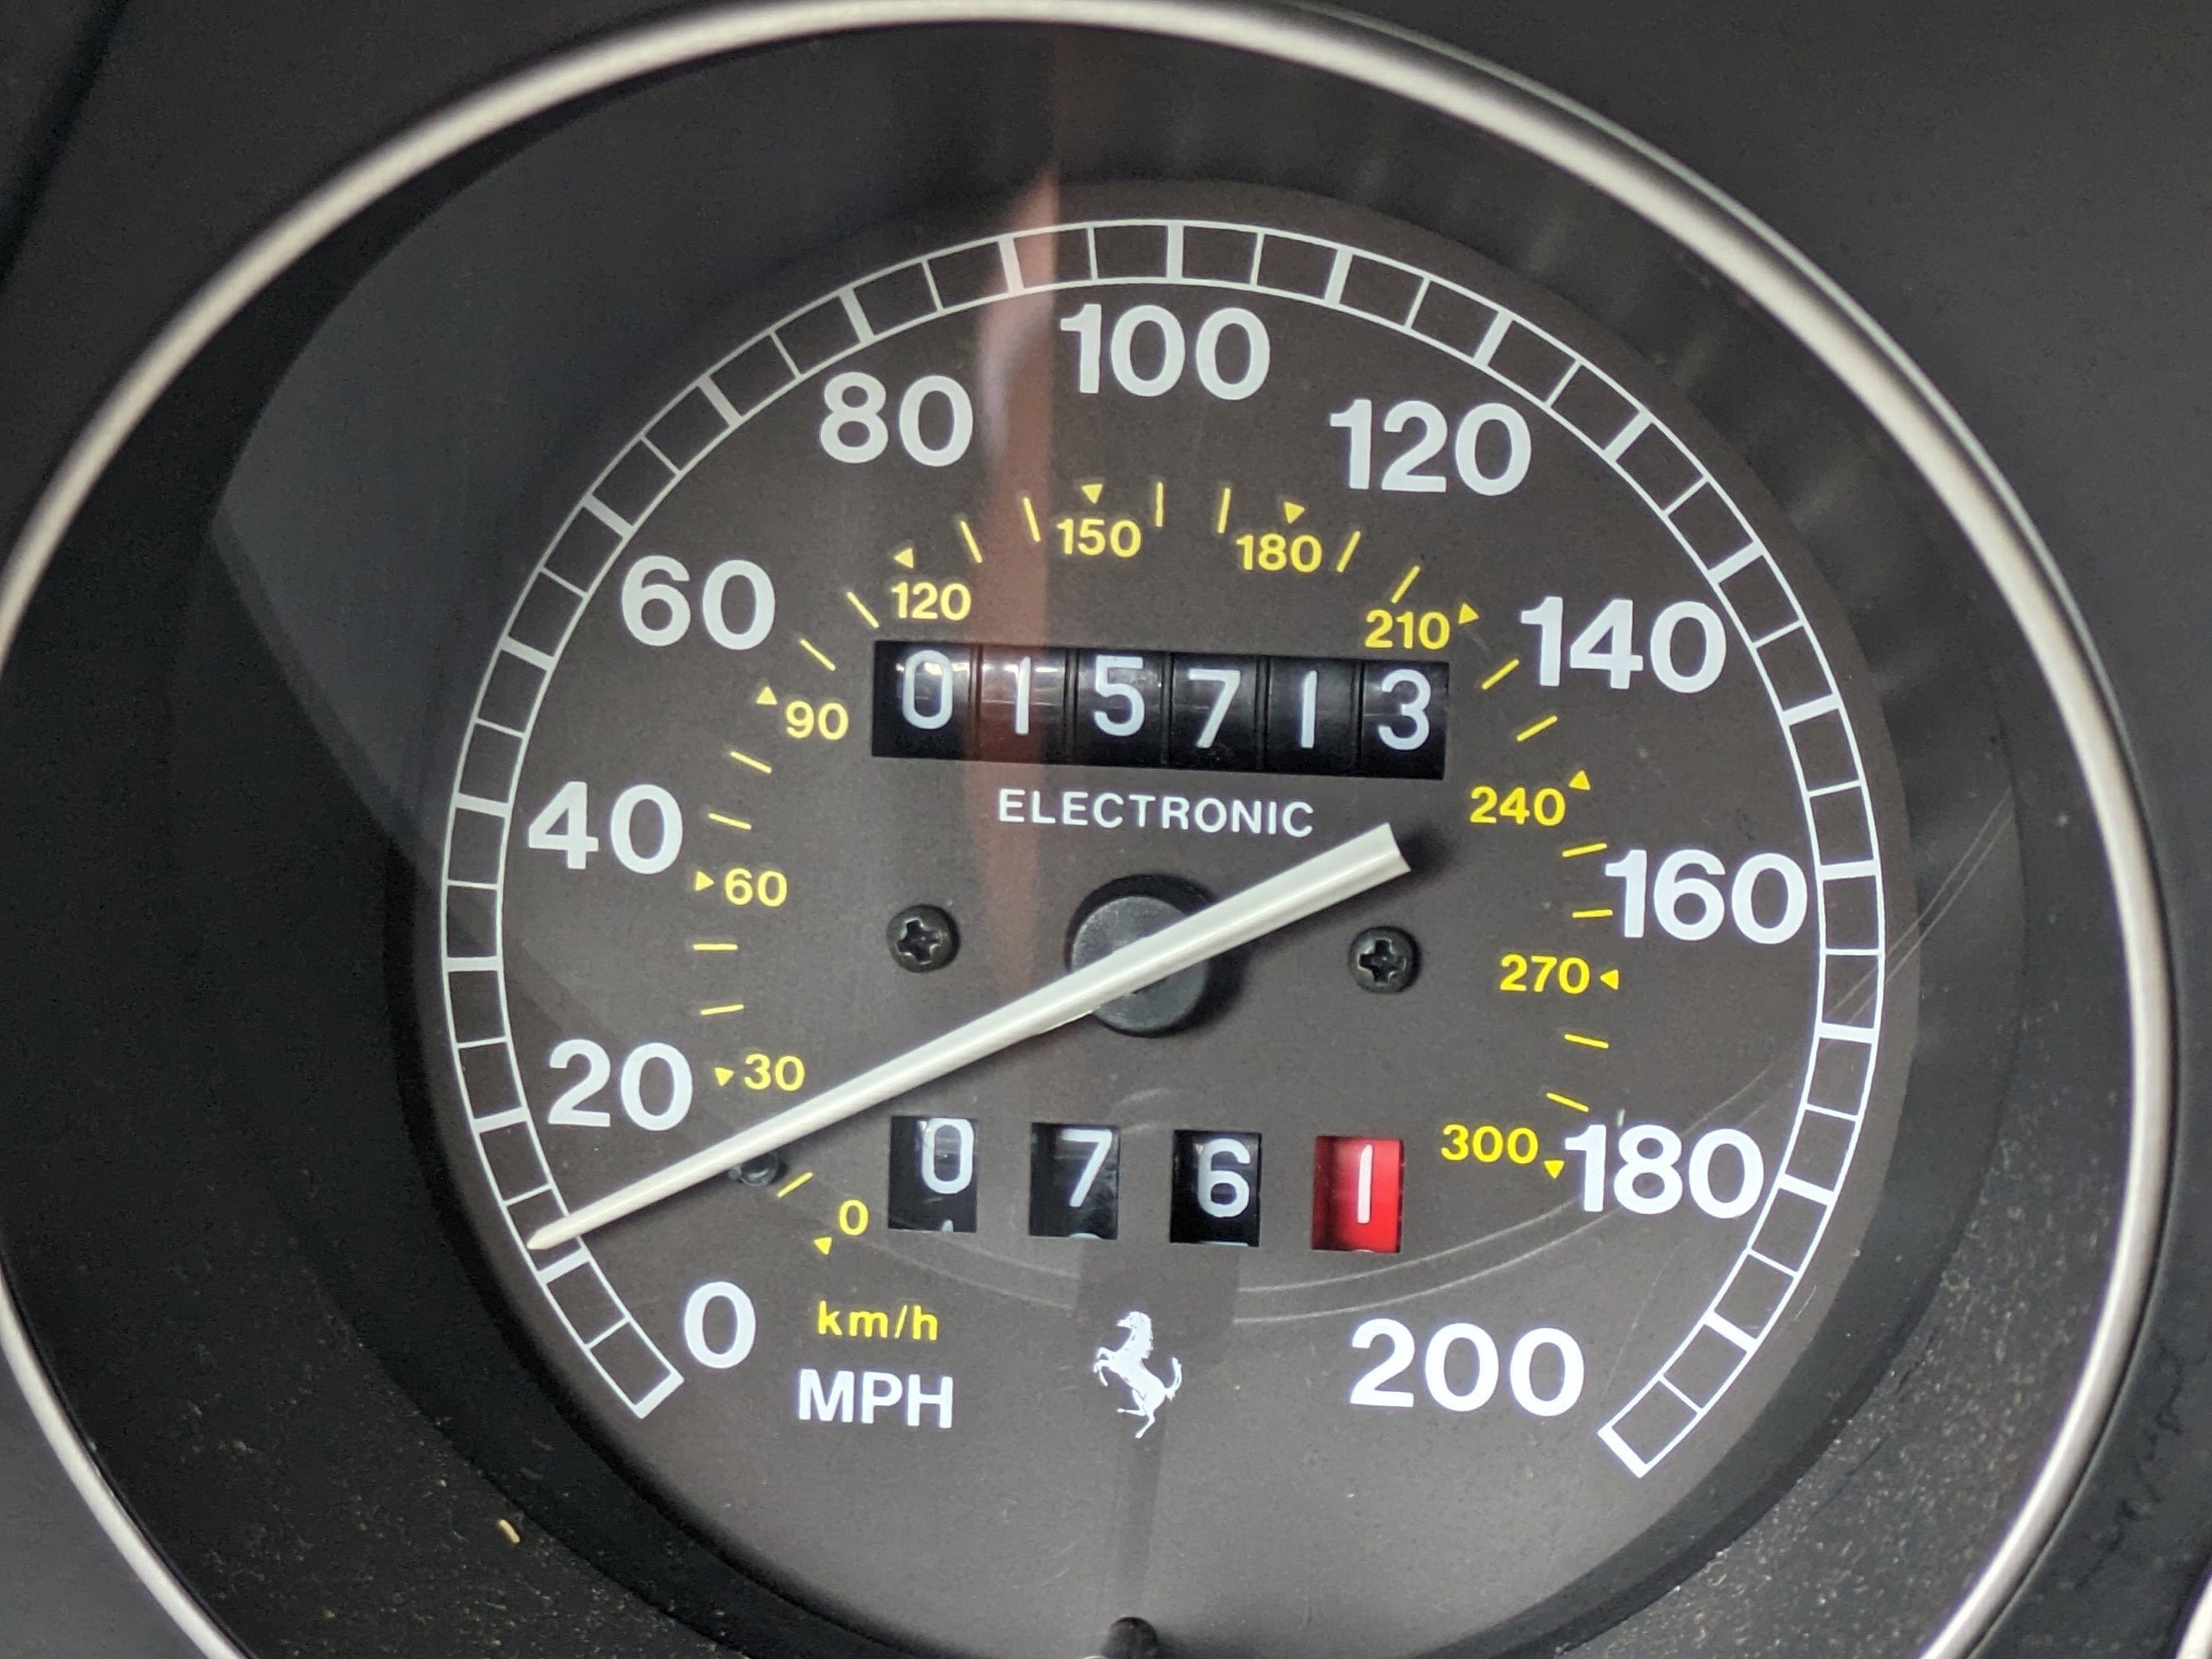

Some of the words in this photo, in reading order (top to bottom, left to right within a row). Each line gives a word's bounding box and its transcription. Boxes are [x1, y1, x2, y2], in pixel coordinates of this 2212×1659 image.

[1059, 302, 1271, 401] 100
[818, 371, 974, 467] 80
[1329, 397, 1533, 497] 120
[1058, 517, 1141, 558] 150
[1236, 531, 1323, 574] 180
[620, 555, 776, 651] 60
[893, 582, 972, 620] 120
[1363, 607, 1452, 651] 210
[1520, 594, 1728, 694] 140
[785, 700, 849, 740] 90
[526, 780, 683, 875] 40
[995, 787, 1313, 838] ELECTRONIC
[1468, 784, 1567, 828] 240
[724, 868, 788, 907] 60
[1604, 849, 1808, 945] 160
[1498, 951, 1592, 996] 270
[546, 1038, 694, 1132] 20
[744, 1052, 805, 1091] 30
[1440, 1122, 1540, 1166] 300
[1562, 1123, 1766, 1220] 180
[836, 1198, 869, 1236] 0
[681, 1280, 757, 1370] 0
[816, 1300, 939, 1341] km/h
[1350, 1318, 1586, 1418] 200
[795, 1367, 954, 1430] MPH
